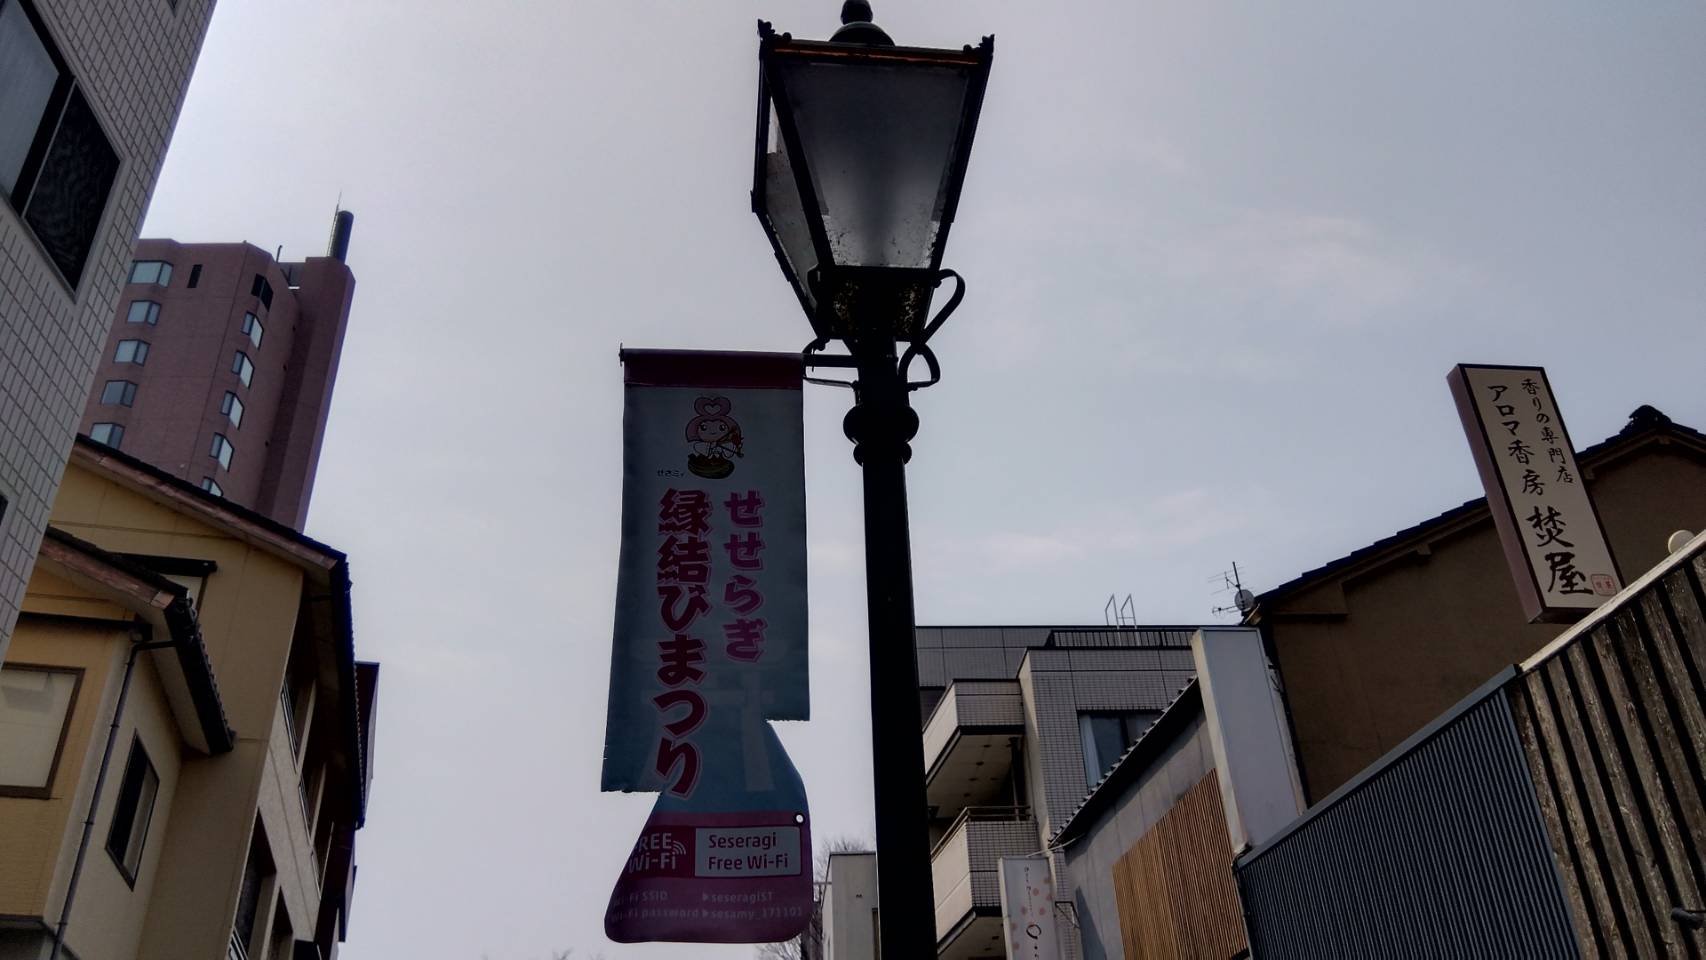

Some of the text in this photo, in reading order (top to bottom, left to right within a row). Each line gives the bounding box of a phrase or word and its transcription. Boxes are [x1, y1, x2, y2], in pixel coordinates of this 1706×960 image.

[1521, 378, 1574, 484] 香りの専門店
[1487, 384, 1594, 596] アロマ香房 焚屋
[723, 489, 768, 663] せせらぎ
[650, 487, 713, 799] 縁結びまつり
[634, 831, 672, 852] REE
[708, 831, 777, 849] Seseragi
[708, 853, 788, 870] Free Wi-Fi
[642, 890, 668, 903] SSID
[641, 907, 698, 921] password
